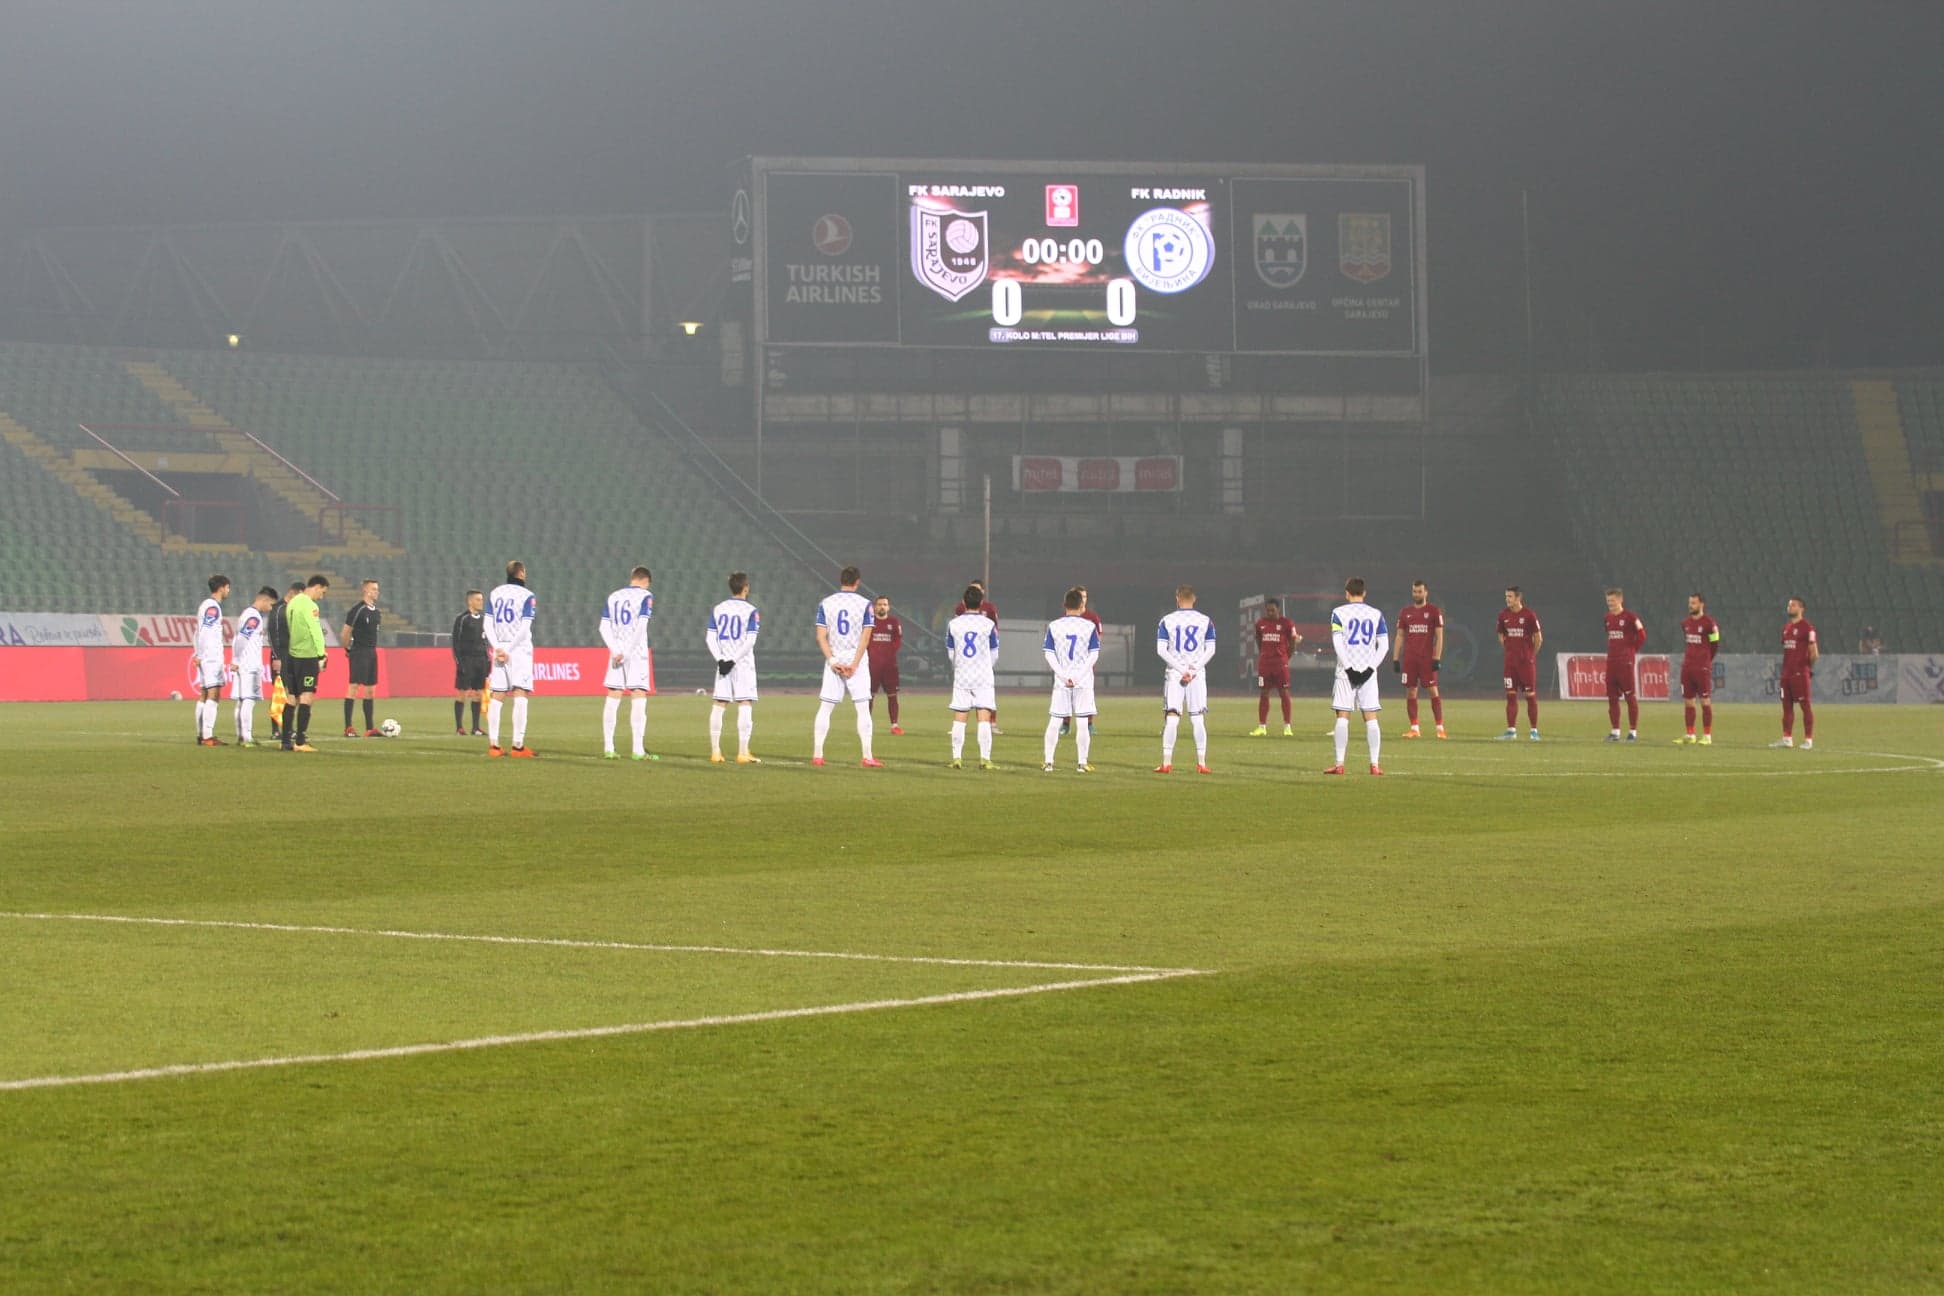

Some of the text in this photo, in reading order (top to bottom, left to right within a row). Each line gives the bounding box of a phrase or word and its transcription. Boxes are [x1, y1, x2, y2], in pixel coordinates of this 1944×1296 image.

[908, 185, 1005, 197] FK SARAJEVO
[1131, 188, 1206, 200] FK RADNIK
[1022, 238, 1103, 265] 00:00
[786, 264, 881, 283] TURKISH
[785, 286, 882, 304] AIRLINES
[992, 279, 1022, 326] 0
[1107, 278, 1136, 326] 0
[494, 598, 515, 624] 26
[613, 601, 632, 626] 16
[837, 609, 850, 636] 6
[718, 613, 742, 641] 20
[1176, 625, 1199, 653] 18
[1348, 618, 1374, 646] 29
[963, 631, 977, 658] 8
[1066, 634, 1078, 661] 7
